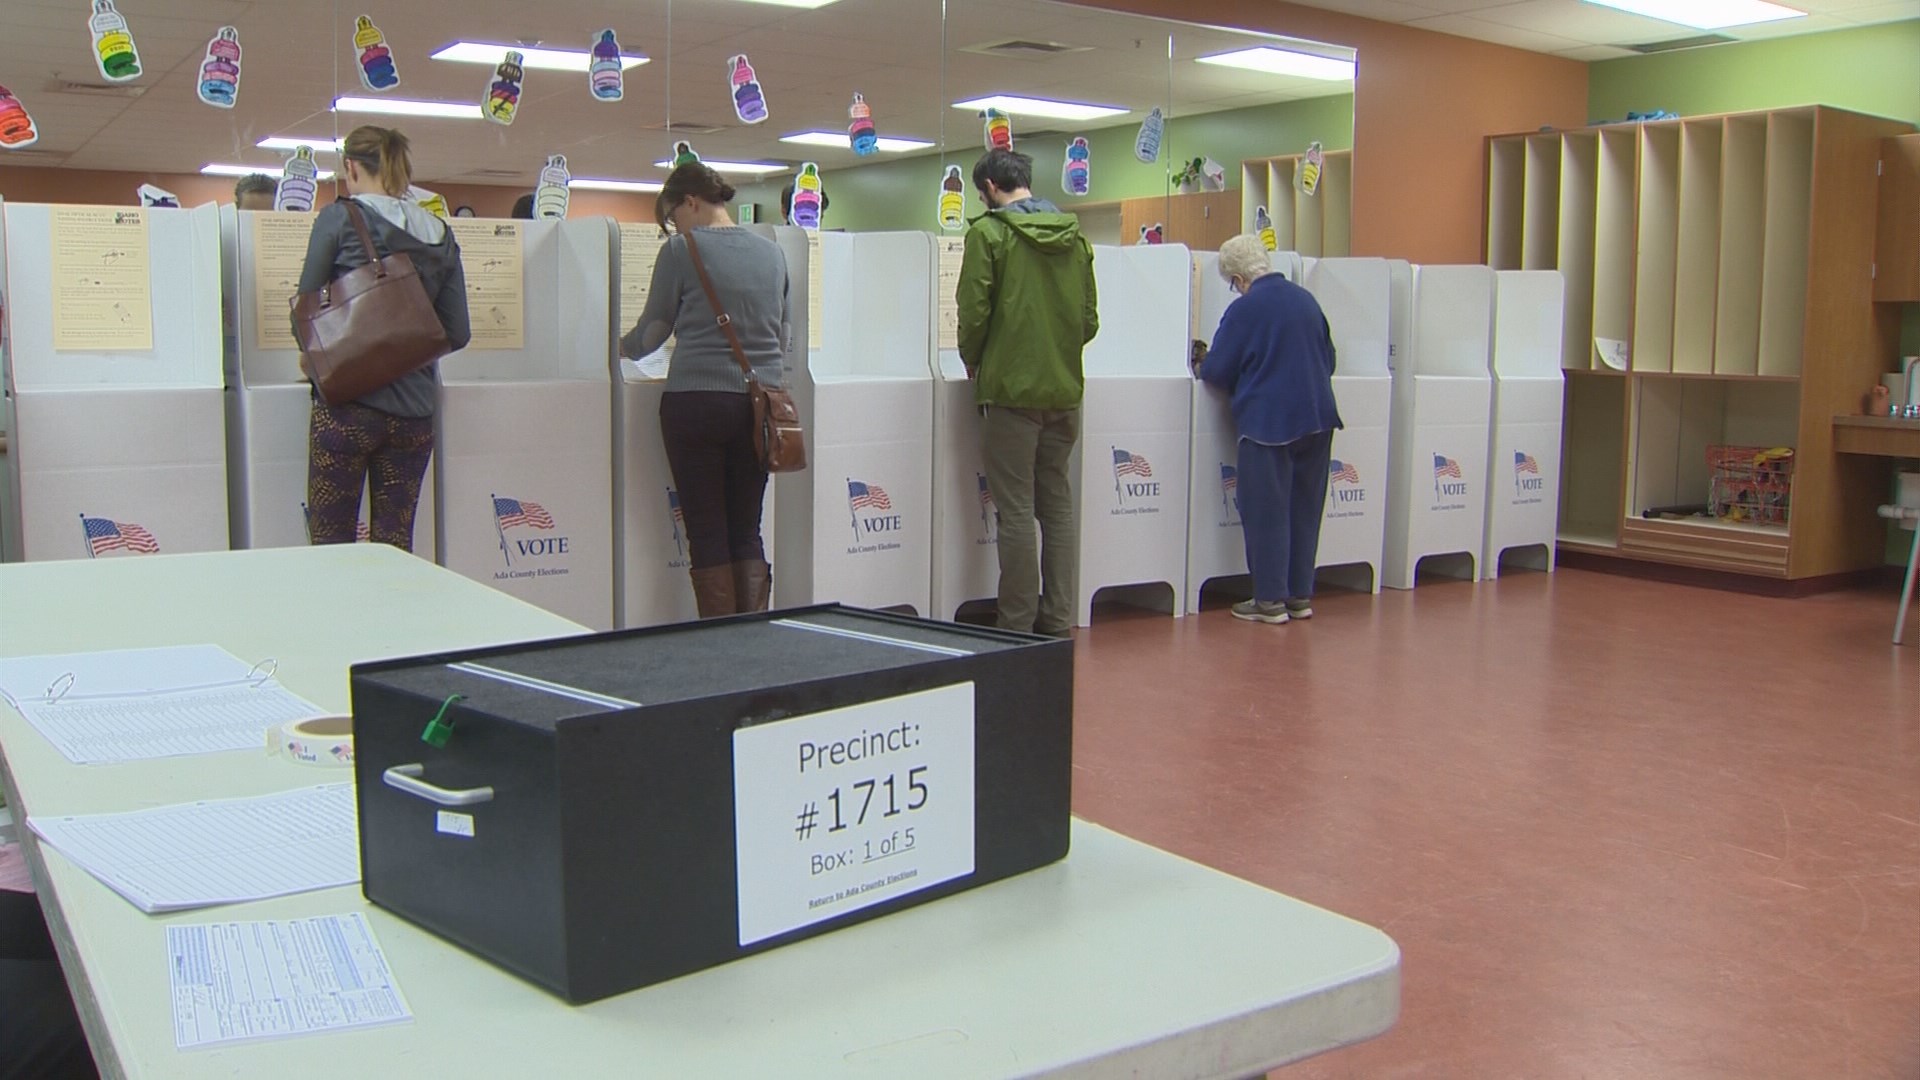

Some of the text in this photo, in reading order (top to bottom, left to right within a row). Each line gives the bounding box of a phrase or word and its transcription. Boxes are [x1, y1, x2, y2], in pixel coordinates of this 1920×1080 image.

[1126, 482, 1160, 497] VOTE
[1443, 483, 1467, 495] VOTE
[1522, 477, 1543, 490] VOTE
[1339, 489, 1366, 502] VOTE
[863, 515, 902, 533] VOTE
[517, 537, 569, 556] VOTE
[493, 567, 569, 579] Ada County Elections
[799, 721, 920, 773] Precinct:
[795, 764, 928, 841] #1715
[810, 827, 916, 875] Box: 1 of 5
[809, 869, 918, 909] Return to Ada County Elections
